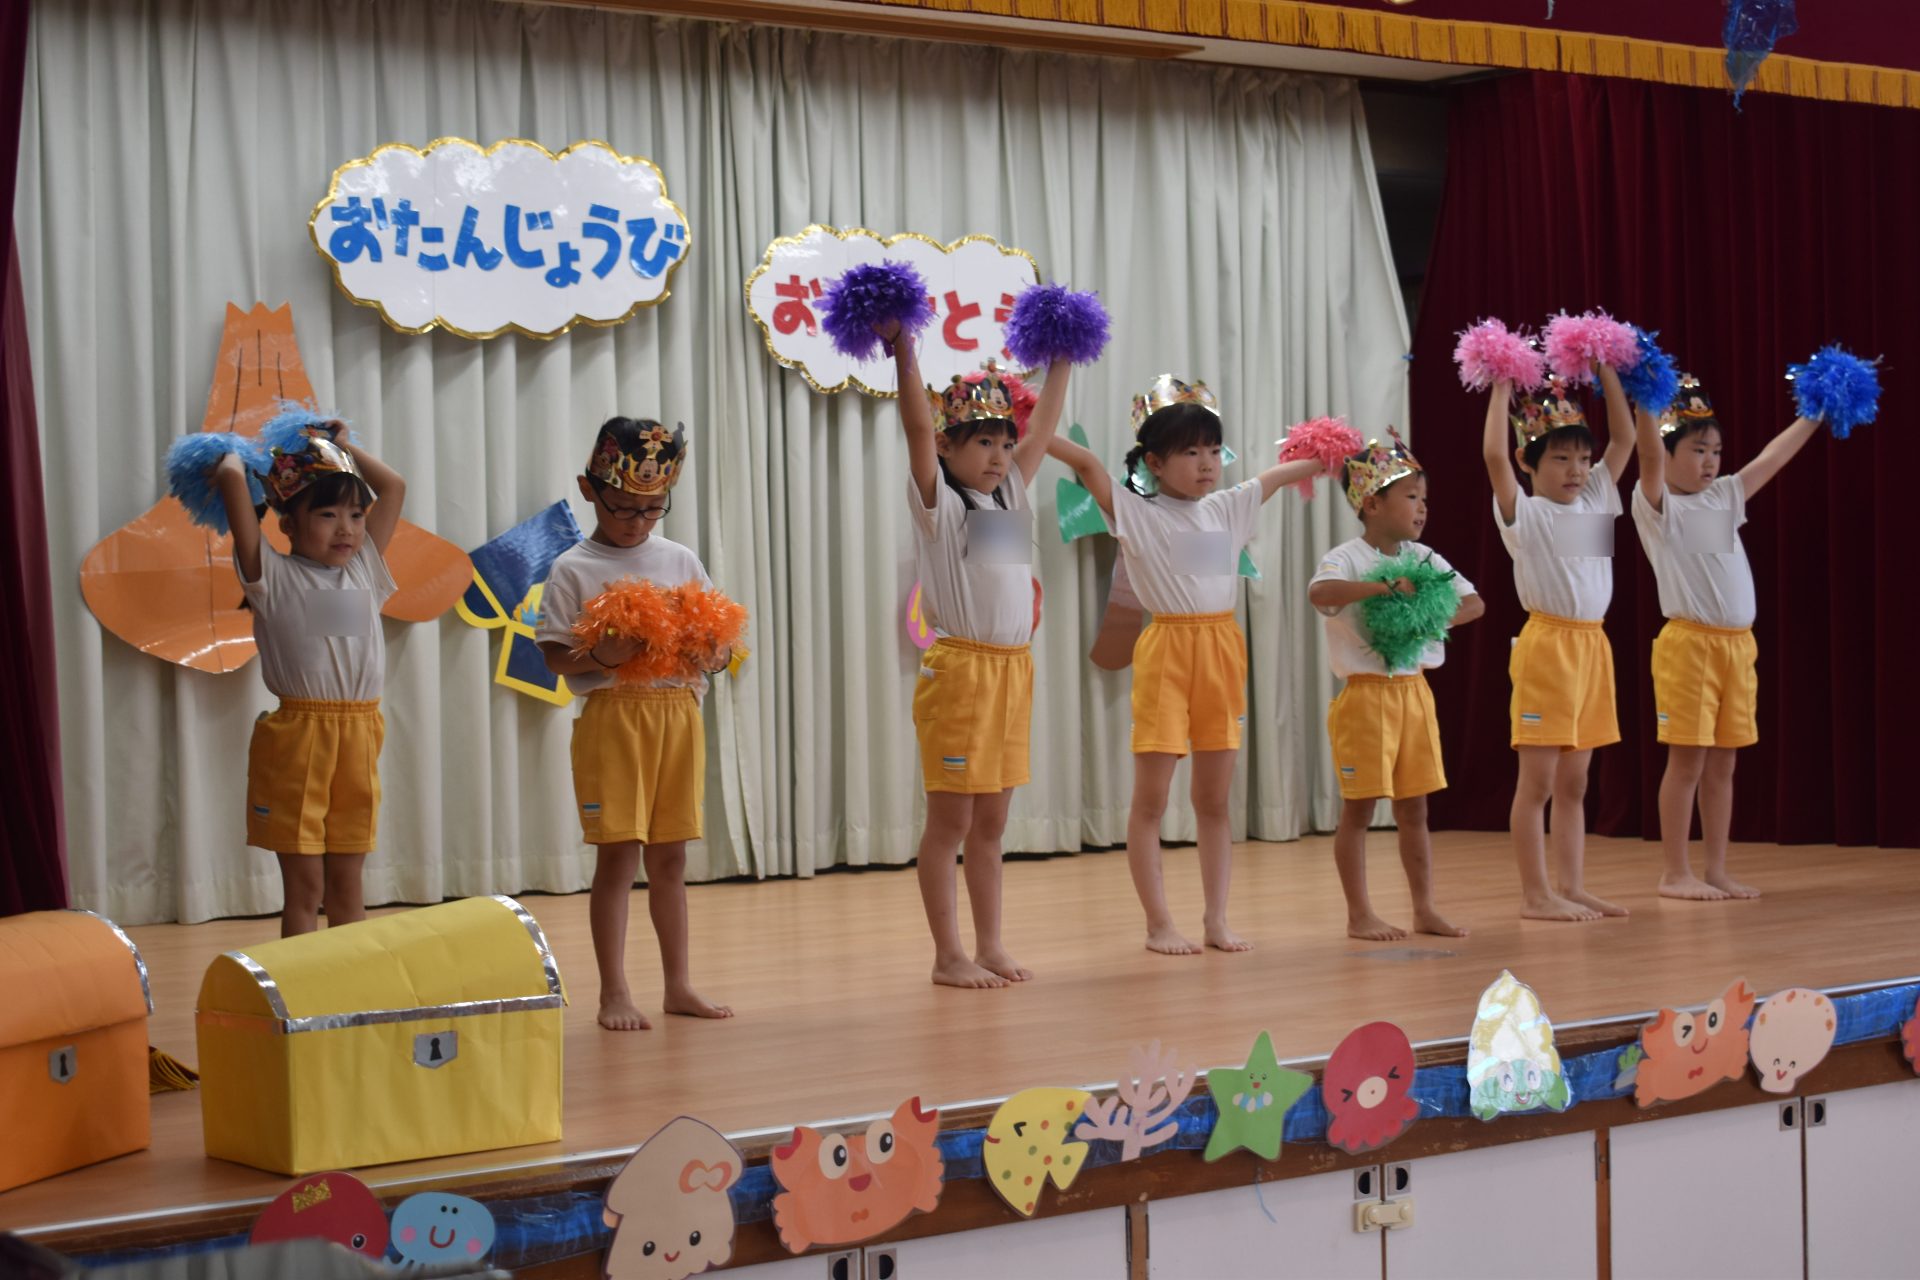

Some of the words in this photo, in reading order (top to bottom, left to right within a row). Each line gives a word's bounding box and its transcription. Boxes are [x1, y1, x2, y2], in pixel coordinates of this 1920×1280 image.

[329, 197, 685, 288] おたんじょうび
